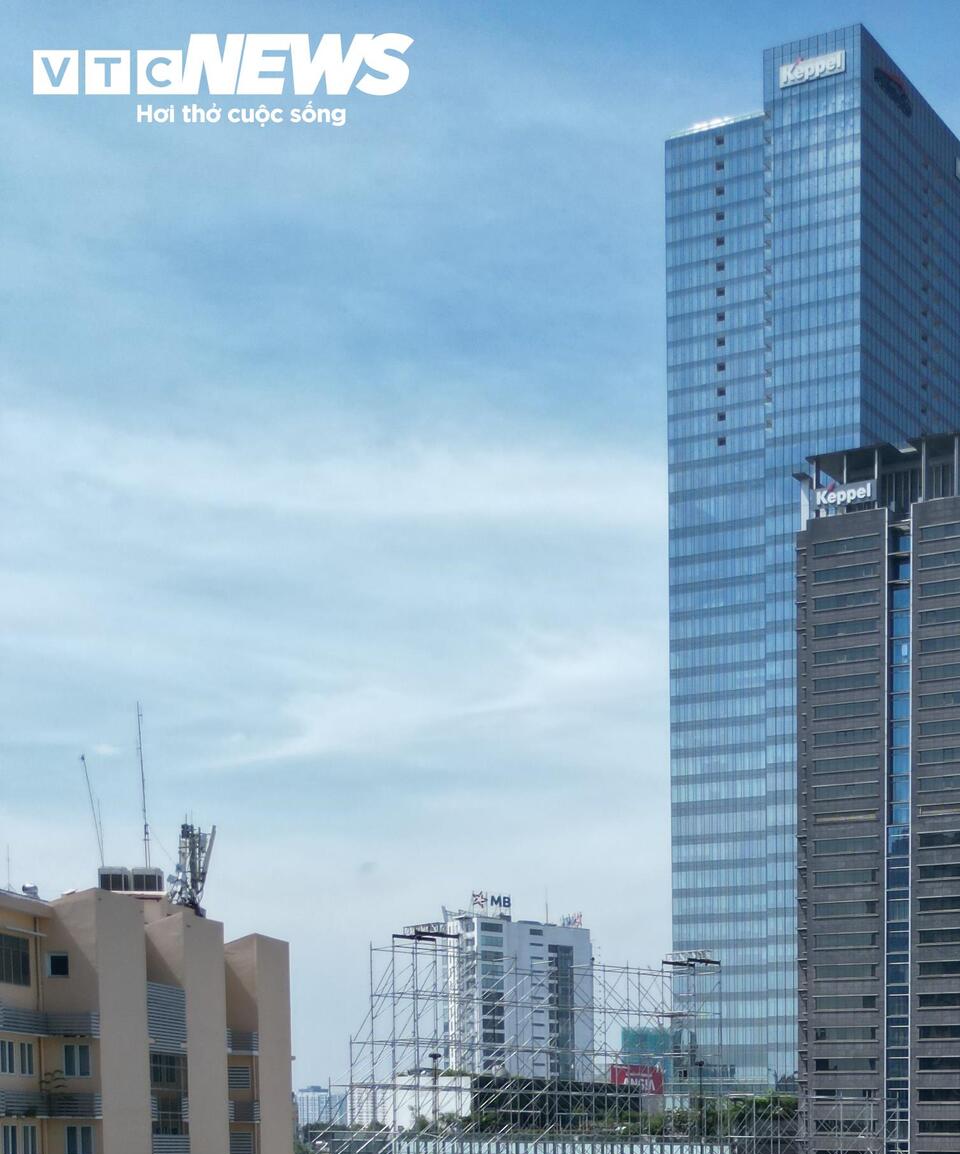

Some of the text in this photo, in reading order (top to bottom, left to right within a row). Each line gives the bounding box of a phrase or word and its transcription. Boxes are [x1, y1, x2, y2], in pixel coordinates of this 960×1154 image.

[781, 51, 843, 84] Keppel
[816, 482, 872, 505] Keppel
[490, 895, 511, 908] MB
